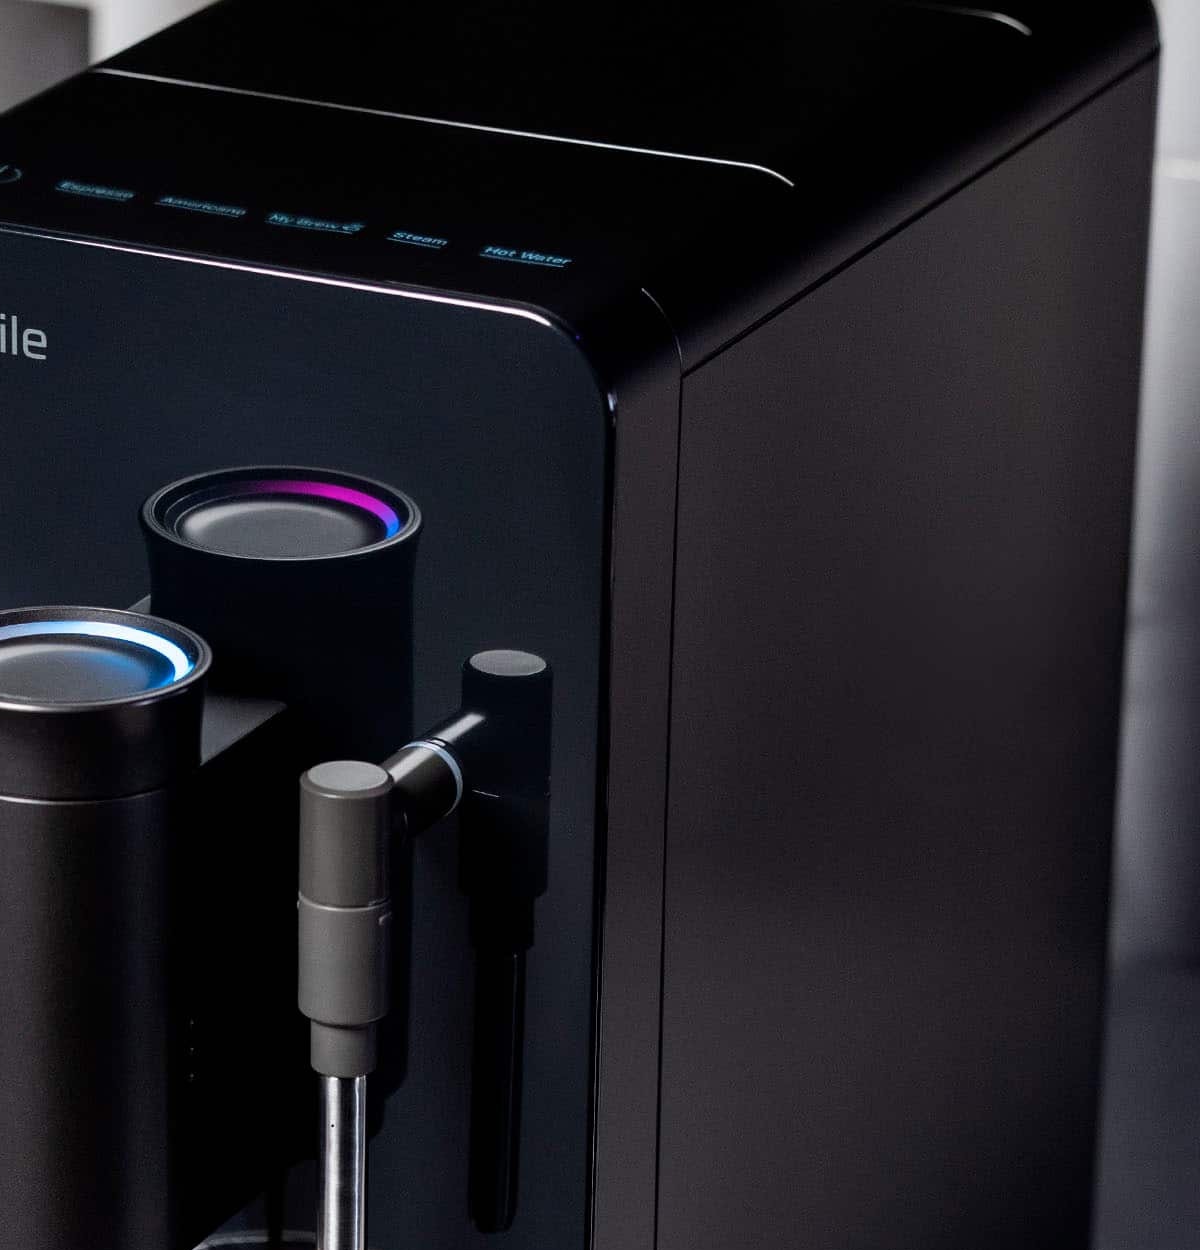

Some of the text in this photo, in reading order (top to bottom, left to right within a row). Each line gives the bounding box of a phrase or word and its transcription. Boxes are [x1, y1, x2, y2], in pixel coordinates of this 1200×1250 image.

[393, 232, 448, 246] Steam
[485, 246, 572, 265] Hot Water
